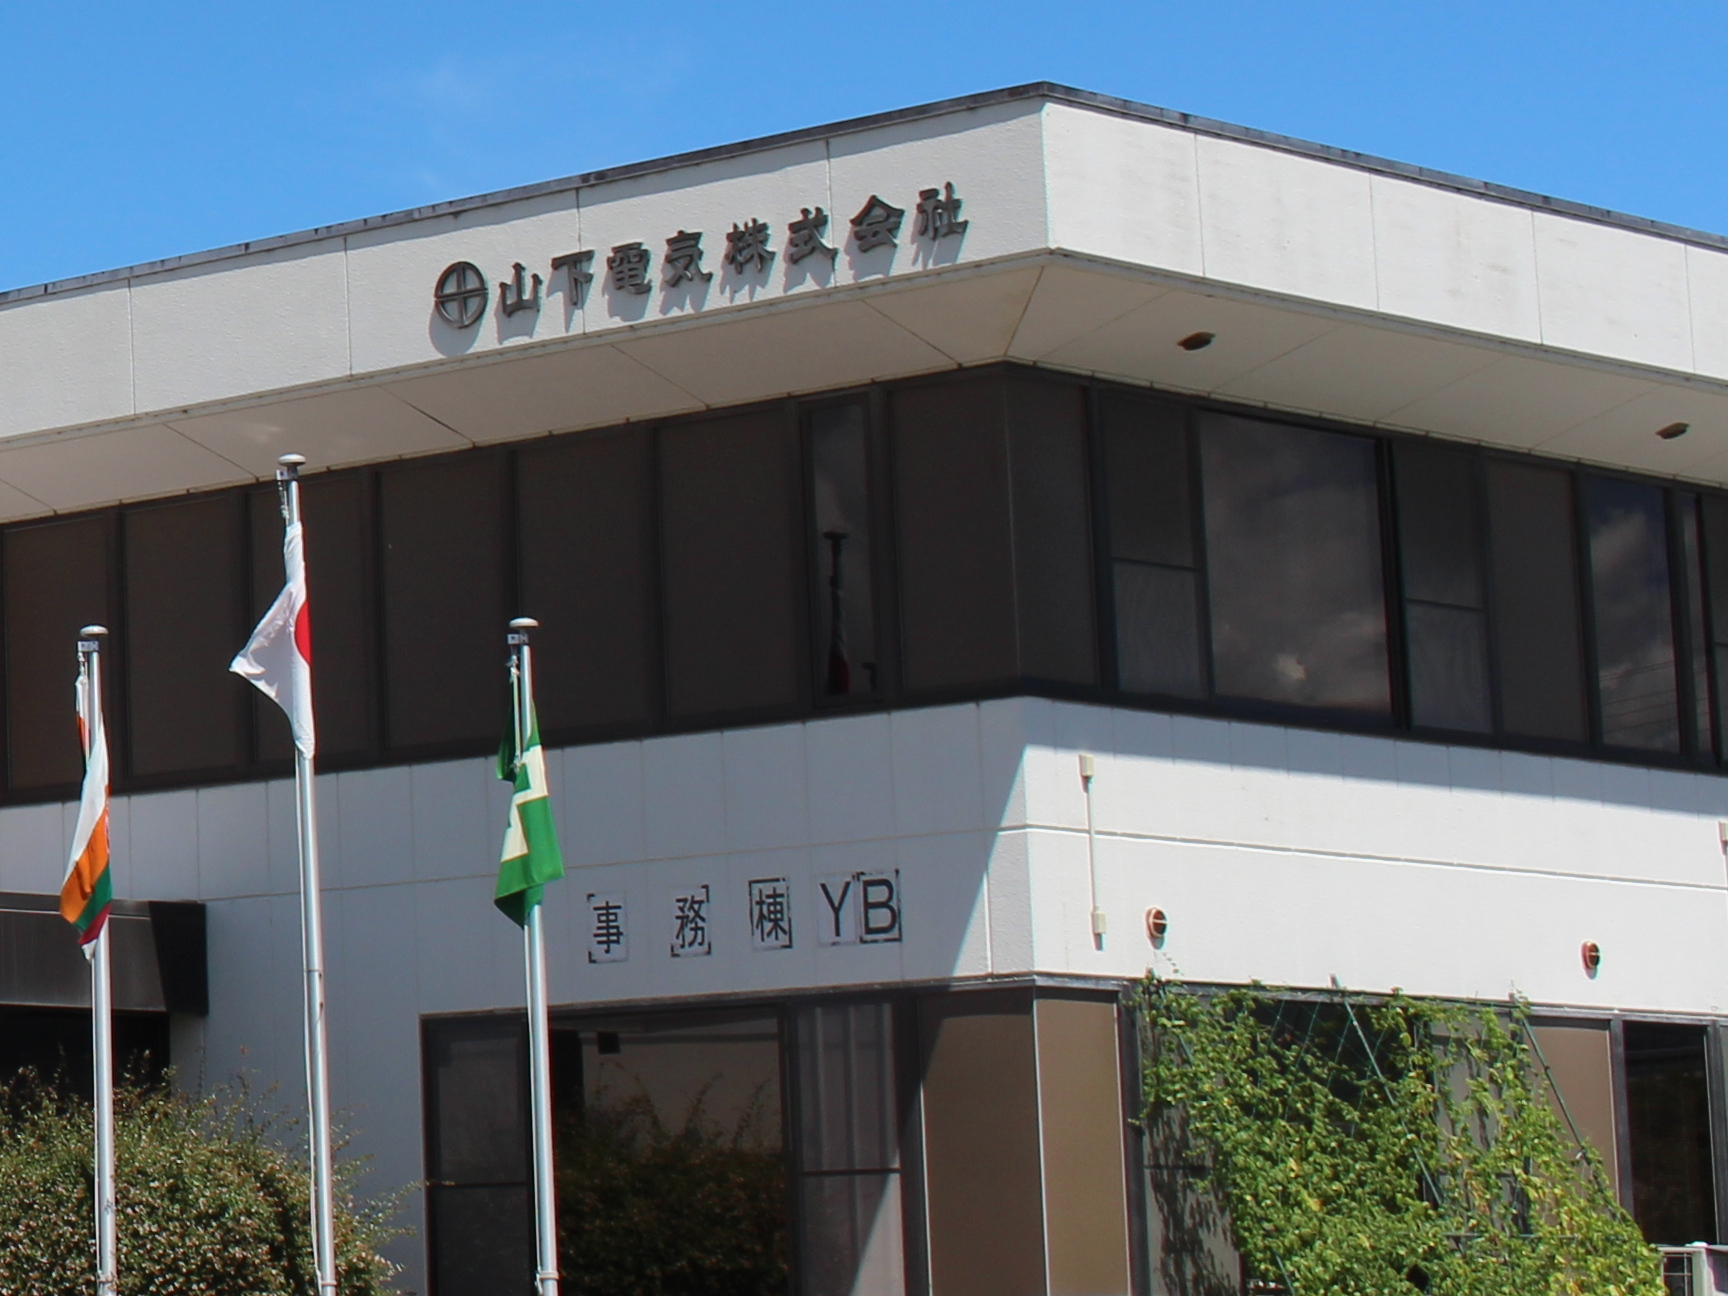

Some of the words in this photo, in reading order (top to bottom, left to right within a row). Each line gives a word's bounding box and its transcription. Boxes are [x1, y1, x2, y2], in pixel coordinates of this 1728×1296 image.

[498, 181, 970, 320] 山下電気株式会社
